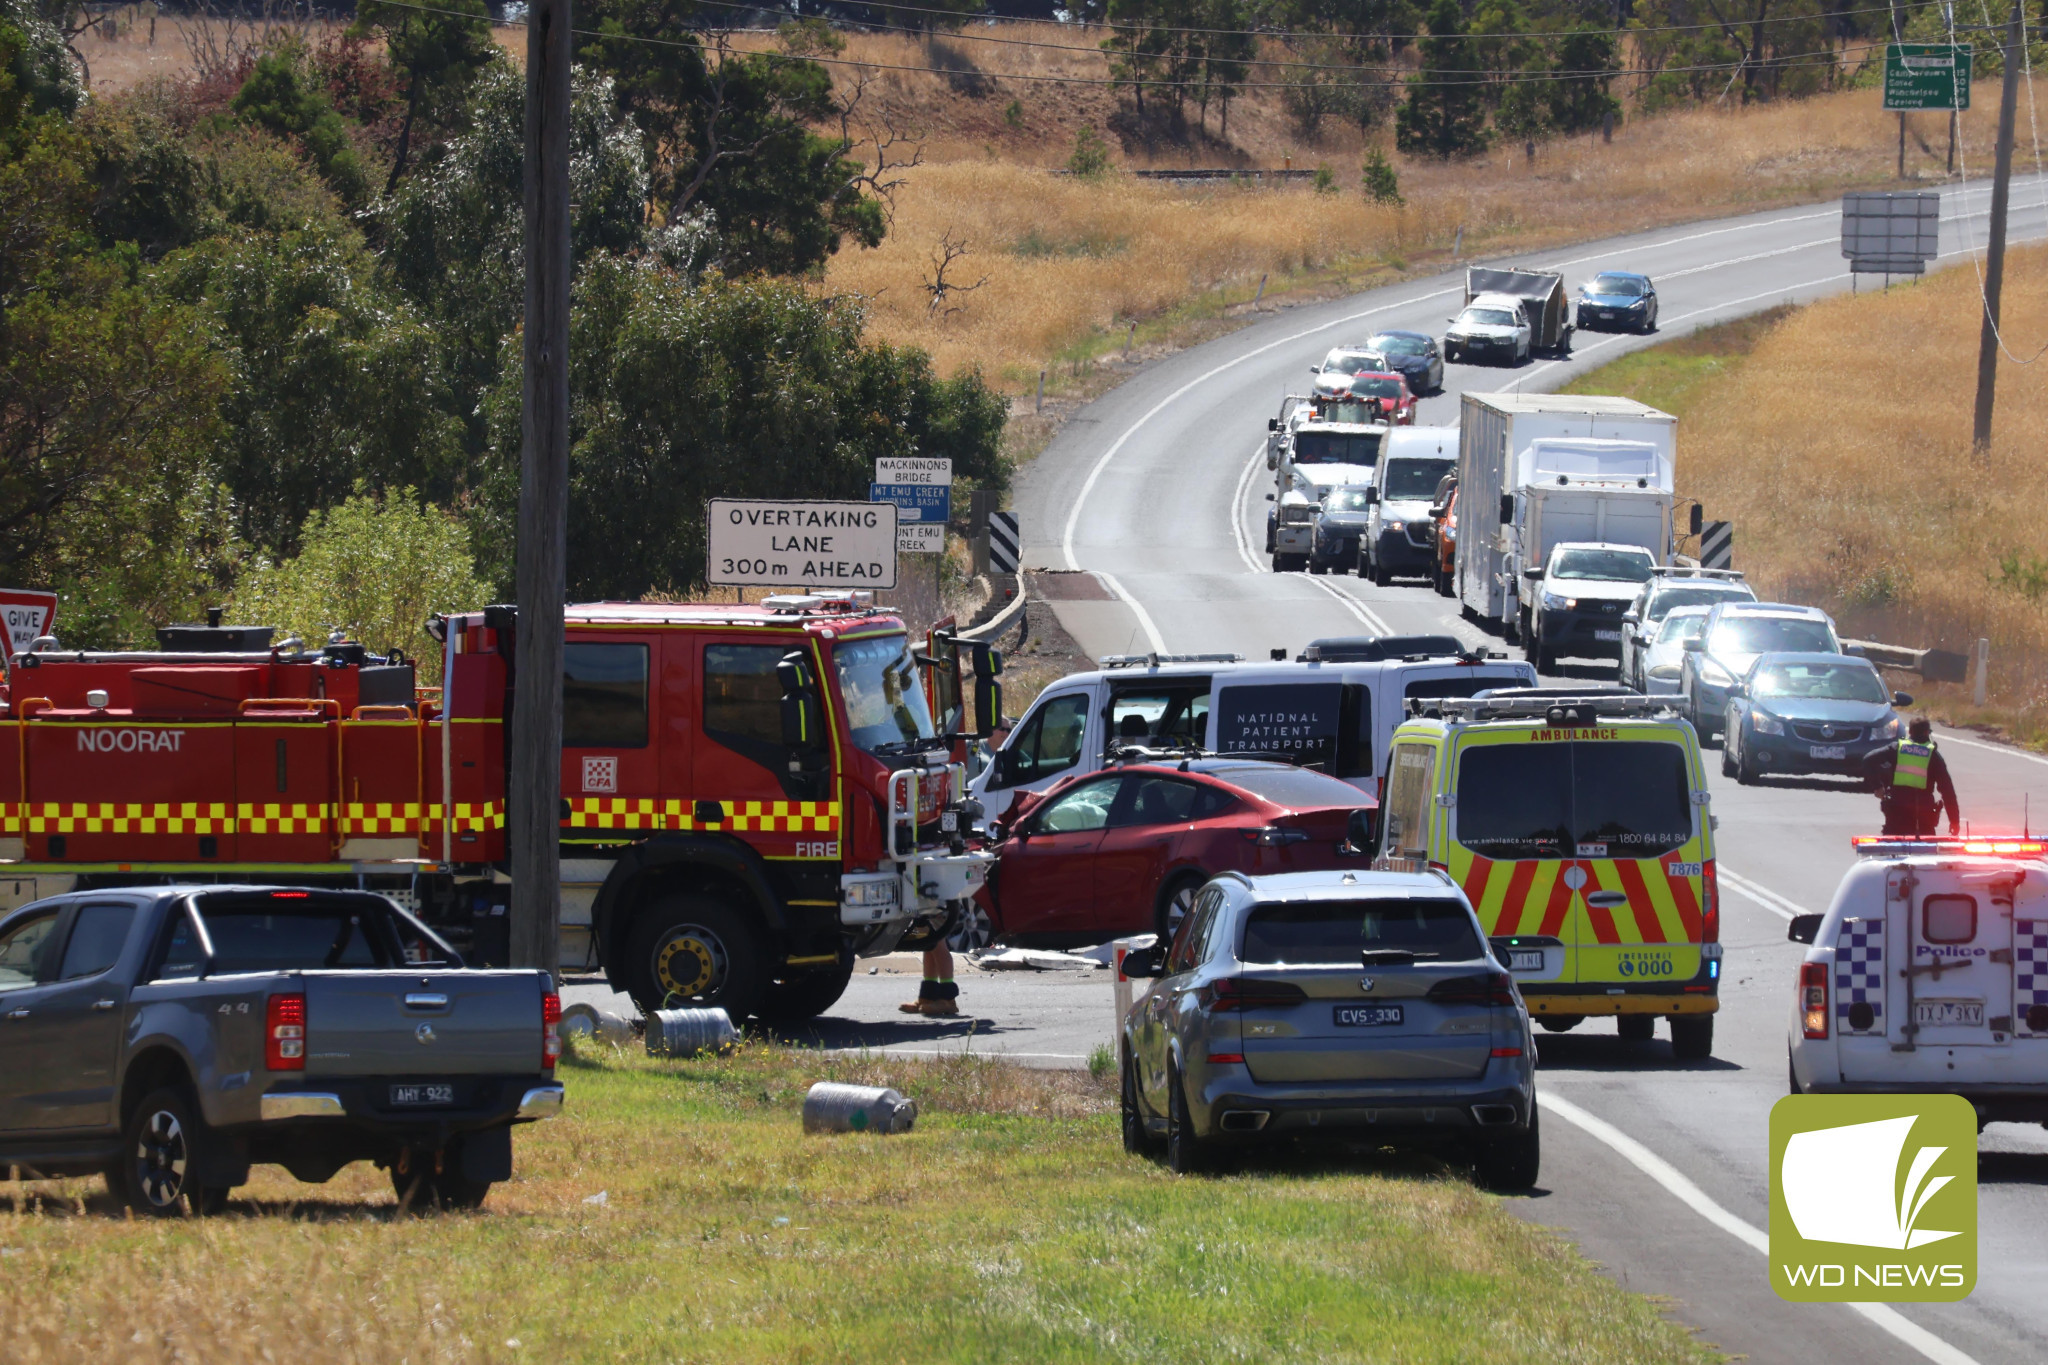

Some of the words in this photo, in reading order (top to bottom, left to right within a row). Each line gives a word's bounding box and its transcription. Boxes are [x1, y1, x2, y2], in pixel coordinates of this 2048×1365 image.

[880, 460, 948, 470] MACKINNONS
[895, 473, 932, 482] BRIDGE
[875, 486, 886, 496] MT
[892, 486, 911, 496] EMU
[916, 487, 945, 498] CREEK
[917, 498, 940, 506] BASIN
[730, 509, 877, 528] OVERTAKING
[918, 528, 940, 537] EMU
[772, 536, 833, 552] LANE
[898, 540, 926, 550] REEK
[722, 559, 788, 576] 300m
[802, 561, 883, 578] AHEAD
[8, 610, 40, 628] GIVE
[14, 631, 34, 644] WAY
[1238, 712, 1318, 724] NATIONAL
[1242, 726, 1310, 736] PATIENT
[1530, 728, 1618, 740] AMBULANCE
[77, 730, 185, 752] NOORAT
[1228, 739, 1324, 750] TRANSPORT
[1901, 745, 1929, 756] Police
[588, 778, 611, 787] CFA
[1620, 834, 1642, 844] 1800
[1644, 834, 1656, 844] 64
[1660, 834, 1671, 843] 84
[1674, 833, 1686, 842] 84
[796, 842, 838, 857] FIRE
[1670, 863, 1700, 876] 7876
[1916, 946, 1986, 956] Police
[1638, 960, 1673, 976] 000
